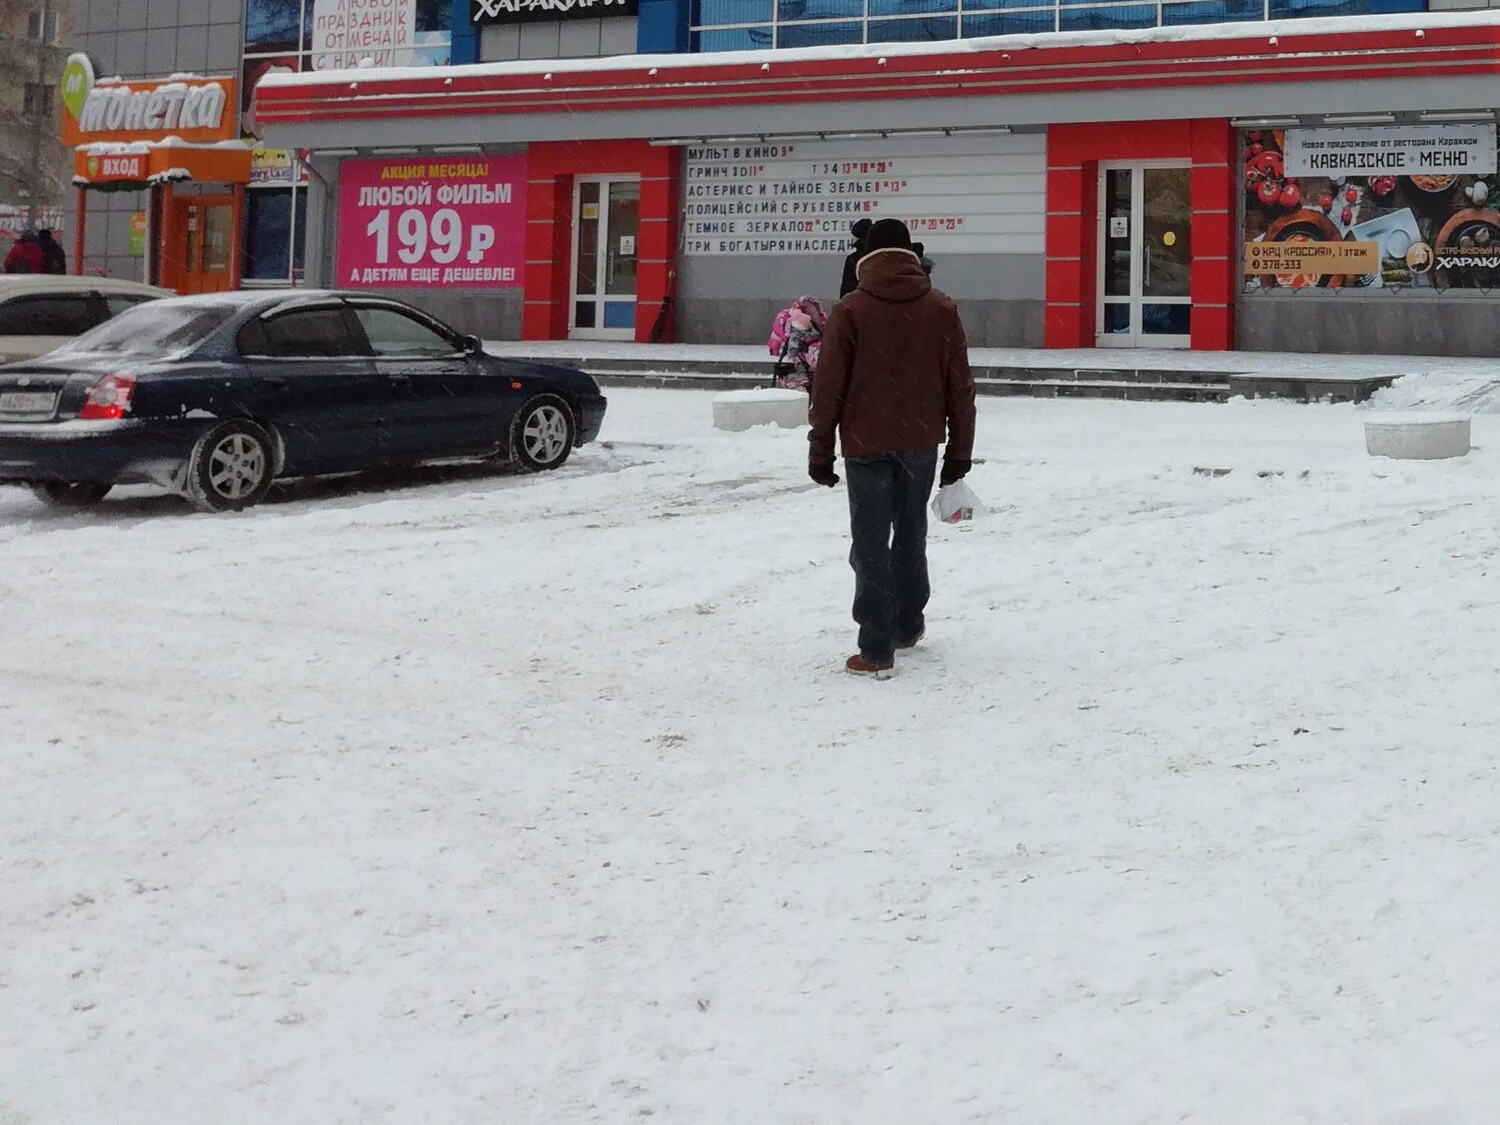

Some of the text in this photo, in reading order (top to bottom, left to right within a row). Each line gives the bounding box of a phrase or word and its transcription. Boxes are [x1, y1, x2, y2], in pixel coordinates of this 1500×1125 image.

[317, 11, 407, 30] ПРАЗДНИК
[325, 25, 407, 49] ОТМЕЧАЙ
[1301, 140, 1325, 150] Новое
[1327, 138, 1378, 149] предложение
[1380, 139, 1392, 148] от
[1394, 138, 1436, 149] ресторана
[688, 146, 729, 160] МУЛЬТ
[733, 147, 740, 159] В
[745, 146, 778, 159] КИНО
[1310, 150, 1468, 169] КАВКАЗСКОЕ МЕНЮ
[103, 157, 140, 177] ВХОД
[381, 163, 489, 179] АКЦИЯ МЕСЯЦА!
[688, 165, 729, 179] ГРИНЧ
[358, 181, 512, 207] ЛЮБОЙ ФИЛЬМ
[688, 184, 754, 198] АСТЕРИКС
[759, 185, 767, 195] И
[773, 181, 822, 196] ТАЙНОЕ
[830, 181, 873, 194] ЗЕЛЬЕ
[687, 200, 778, 217] ПОЛИЦЕЙСКИЙ
[781, 201, 788, 214] С
[793, 200, 861, 214] РУБЛЕВКИ
[688, 220, 736, 234] ТЕМНОЕ
[747, 220, 805, 233] ЗЕРКАЛО
[688, 240, 711, 252] ТРИ
[720, 239, 787, 252] БОГАТЫРЯ
[1344, 248, 1368, 257] этаж
[1261, 259, 1302, 270] 378-333
[350, 267, 515, 284] А ДЕТЯМ ЕЩЕ ДЕШЕВЛЕ!
